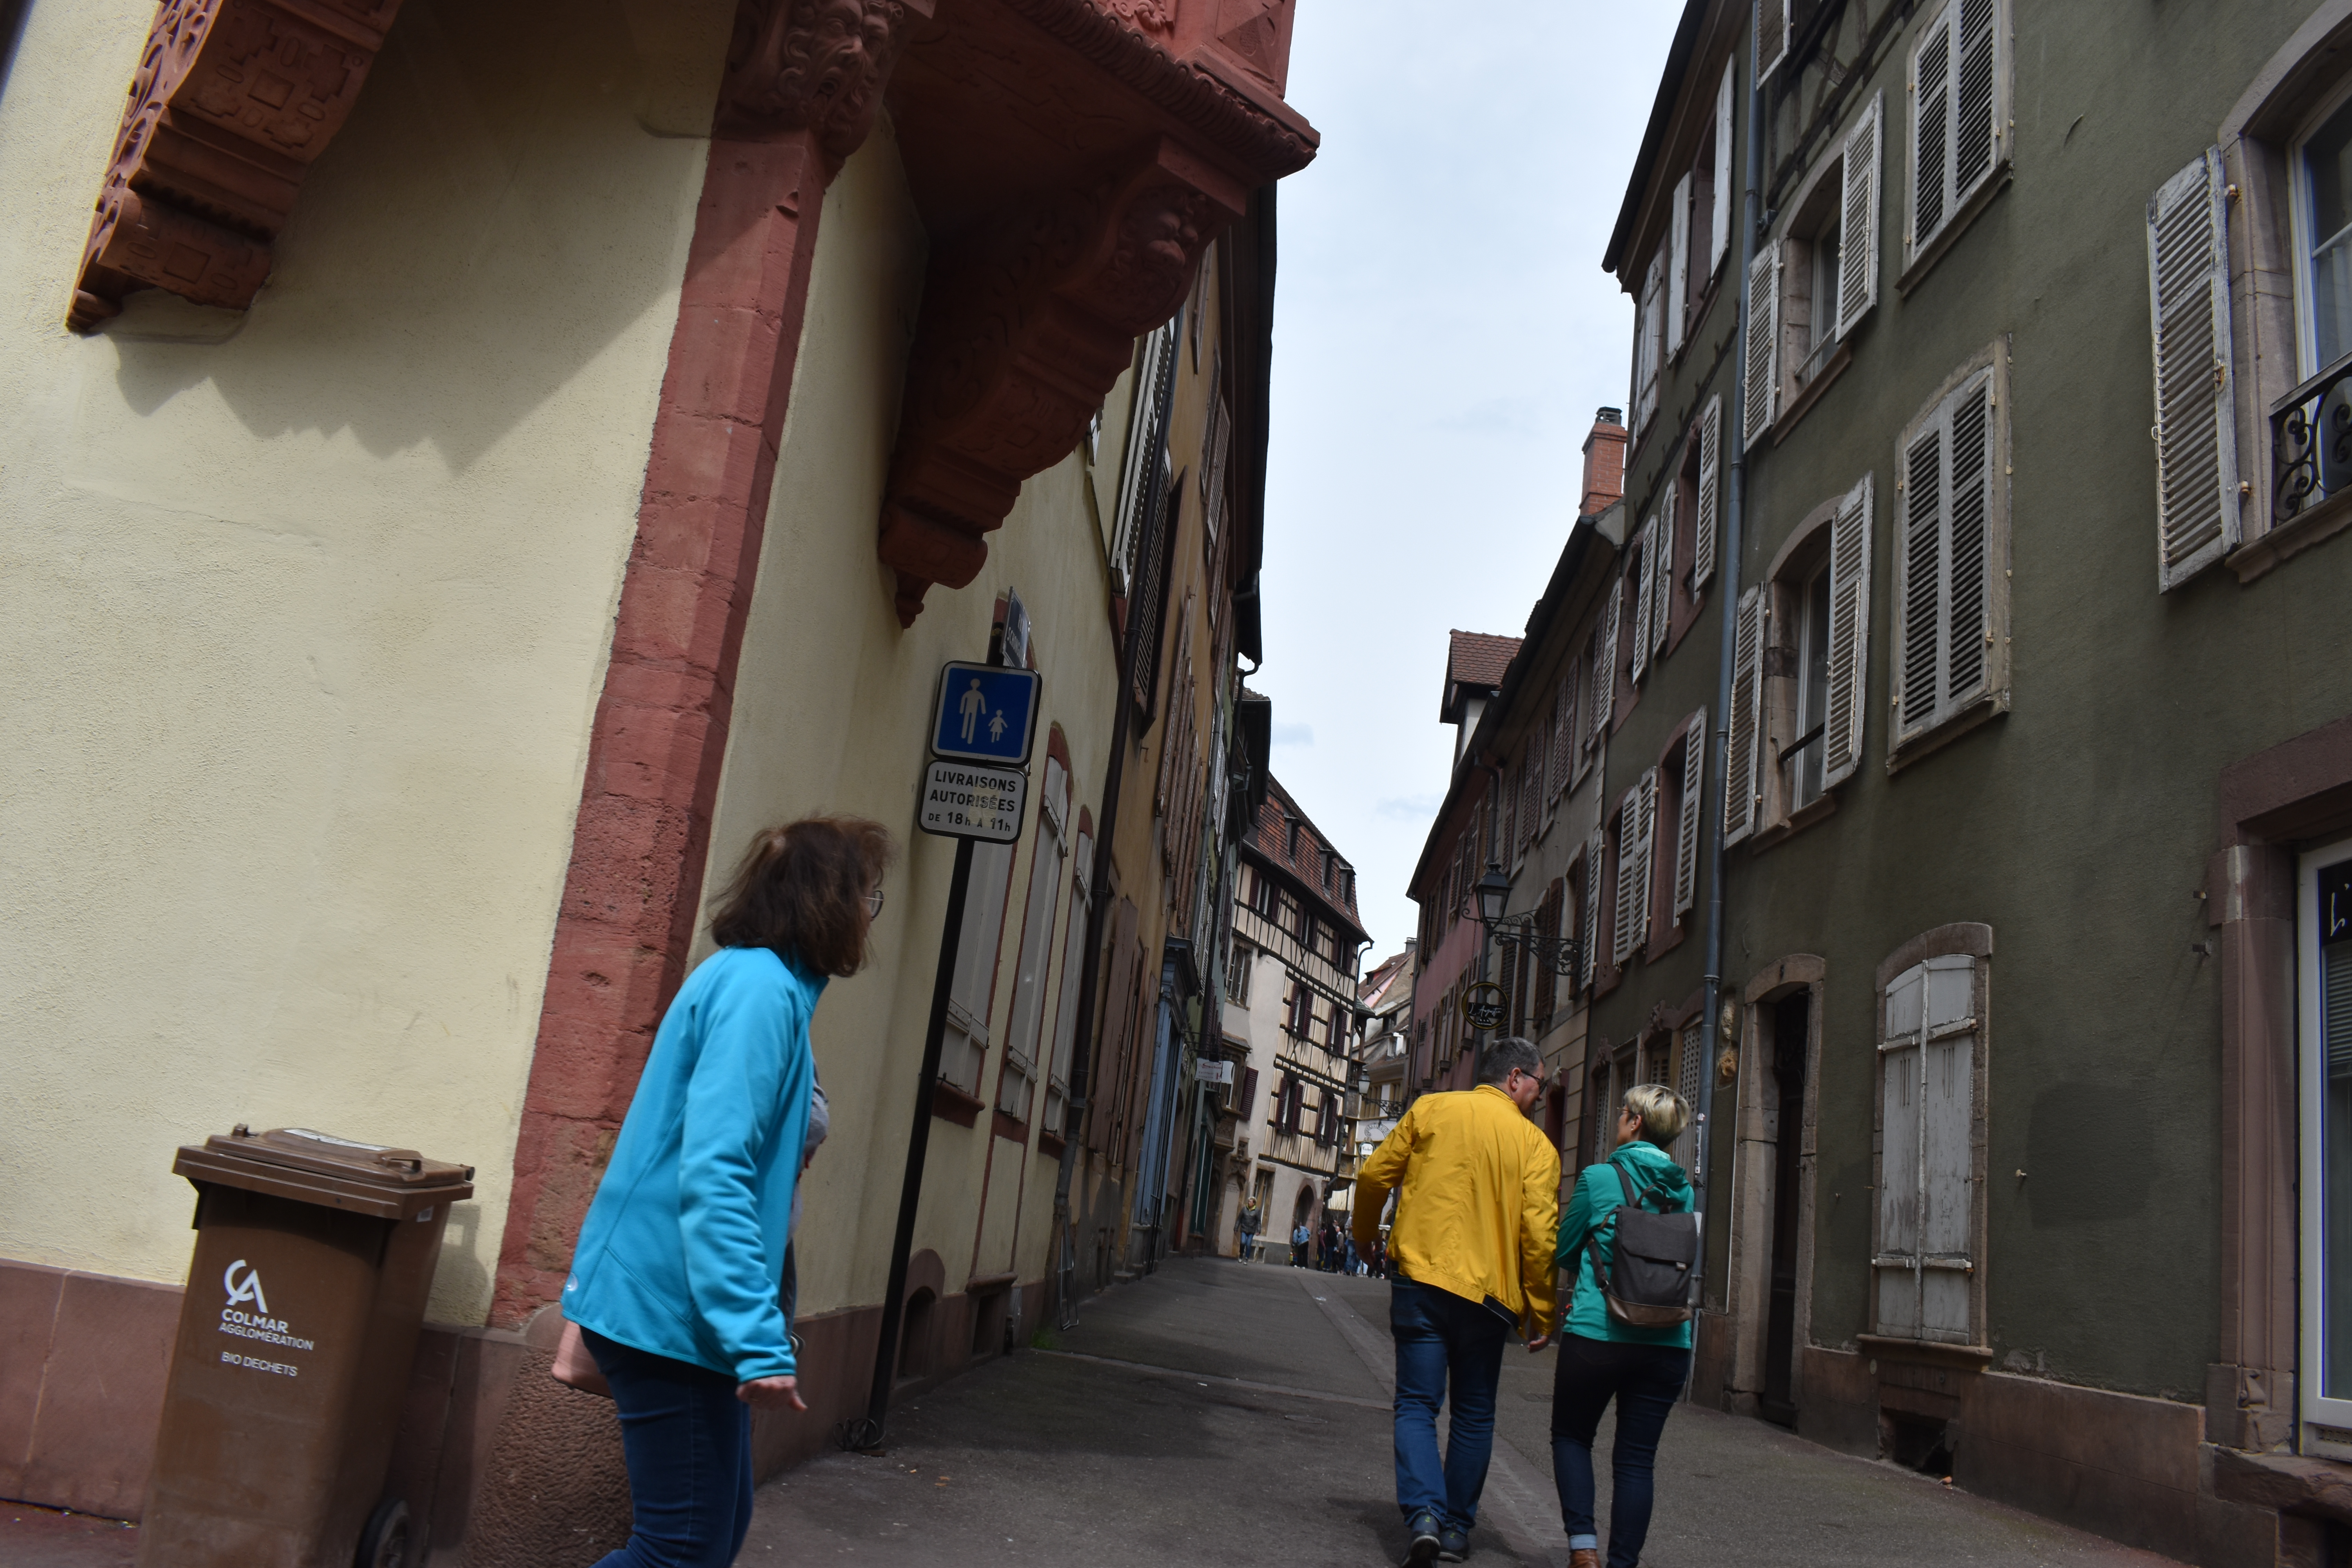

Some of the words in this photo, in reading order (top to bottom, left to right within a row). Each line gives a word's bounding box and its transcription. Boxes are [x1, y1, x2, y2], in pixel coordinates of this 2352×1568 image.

[935, 770, 1016, 792] LIVRAISONS
[930, 789, 1015, 811] AUTORISÉES
[928, 813, 940, 822] DE
[948, 812, 971, 826] 18h
[990, 817, 1010, 831] 11h
[221, 1308, 289, 1334] COLMAR
[218, 1322, 314, 1350] AGGLOMÉRATION
[221, 1351, 242, 1365] BIO
[243, 1356, 298, 1376] DECHETS
